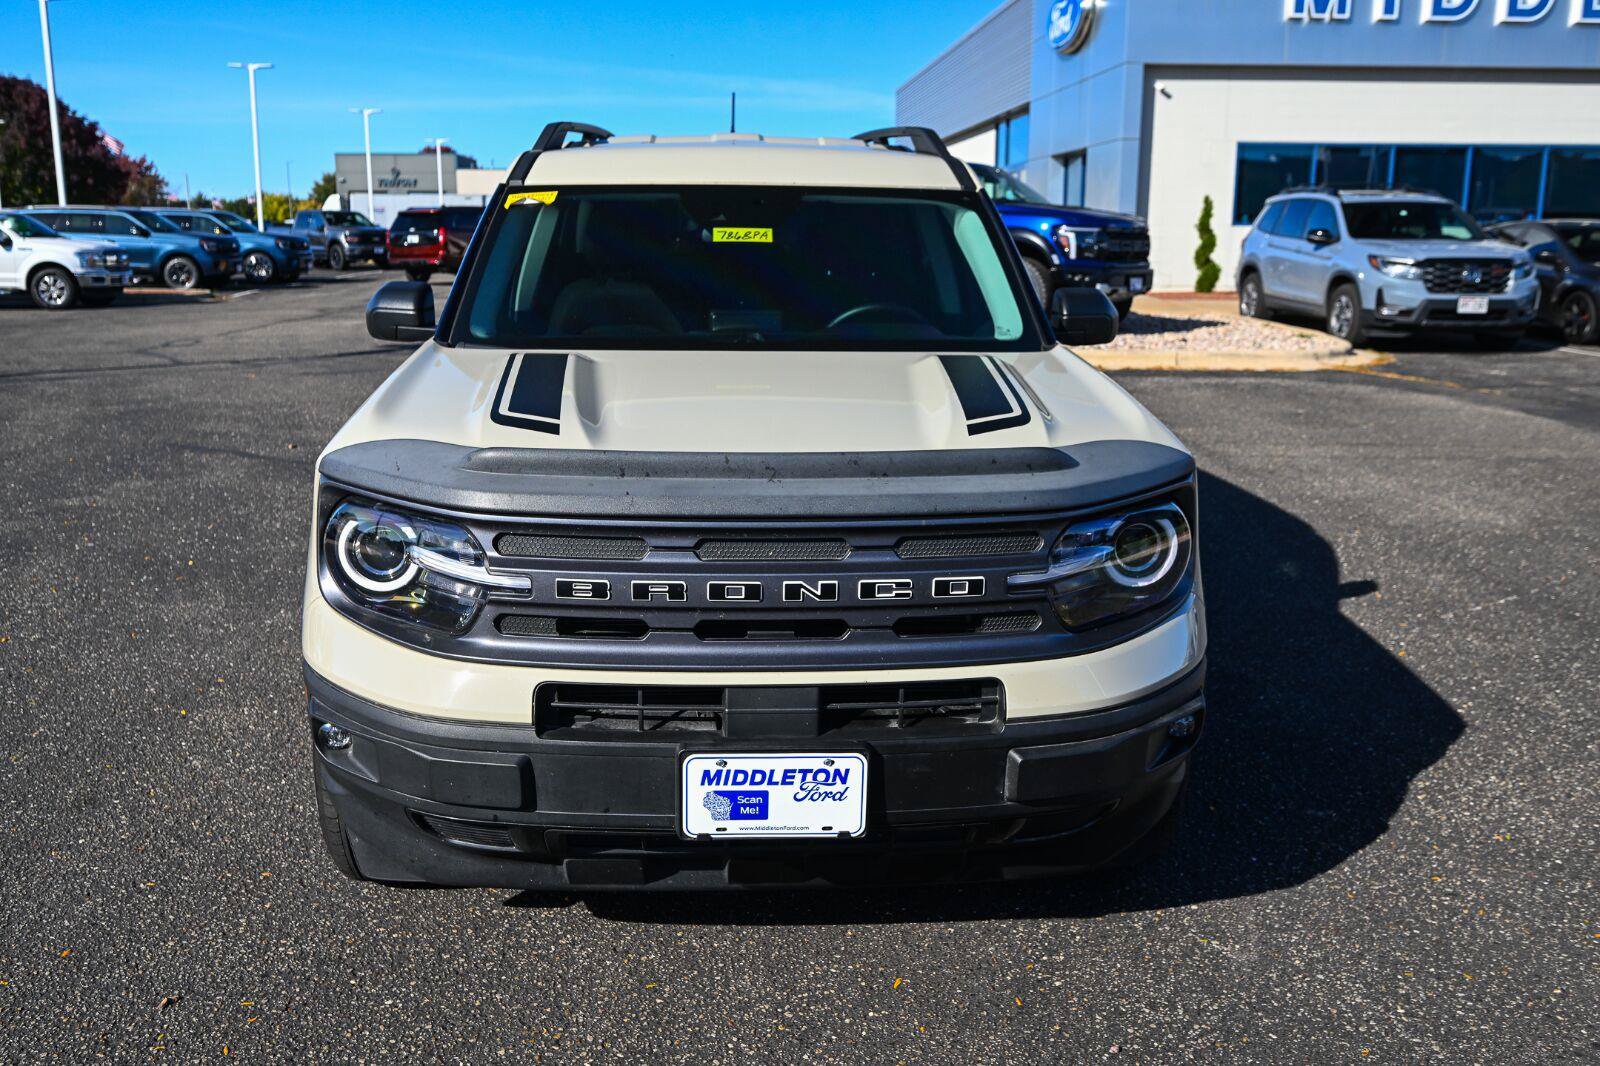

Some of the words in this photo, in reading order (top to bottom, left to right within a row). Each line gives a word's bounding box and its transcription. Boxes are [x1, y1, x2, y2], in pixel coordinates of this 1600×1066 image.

[555, 576, 986, 601] BRONCO
[700, 768, 850, 786] MIDDLETON
[737, 795, 763, 804] Scan
[793, 781, 849, 802] Ford
[740, 806, 760, 815] Me!
